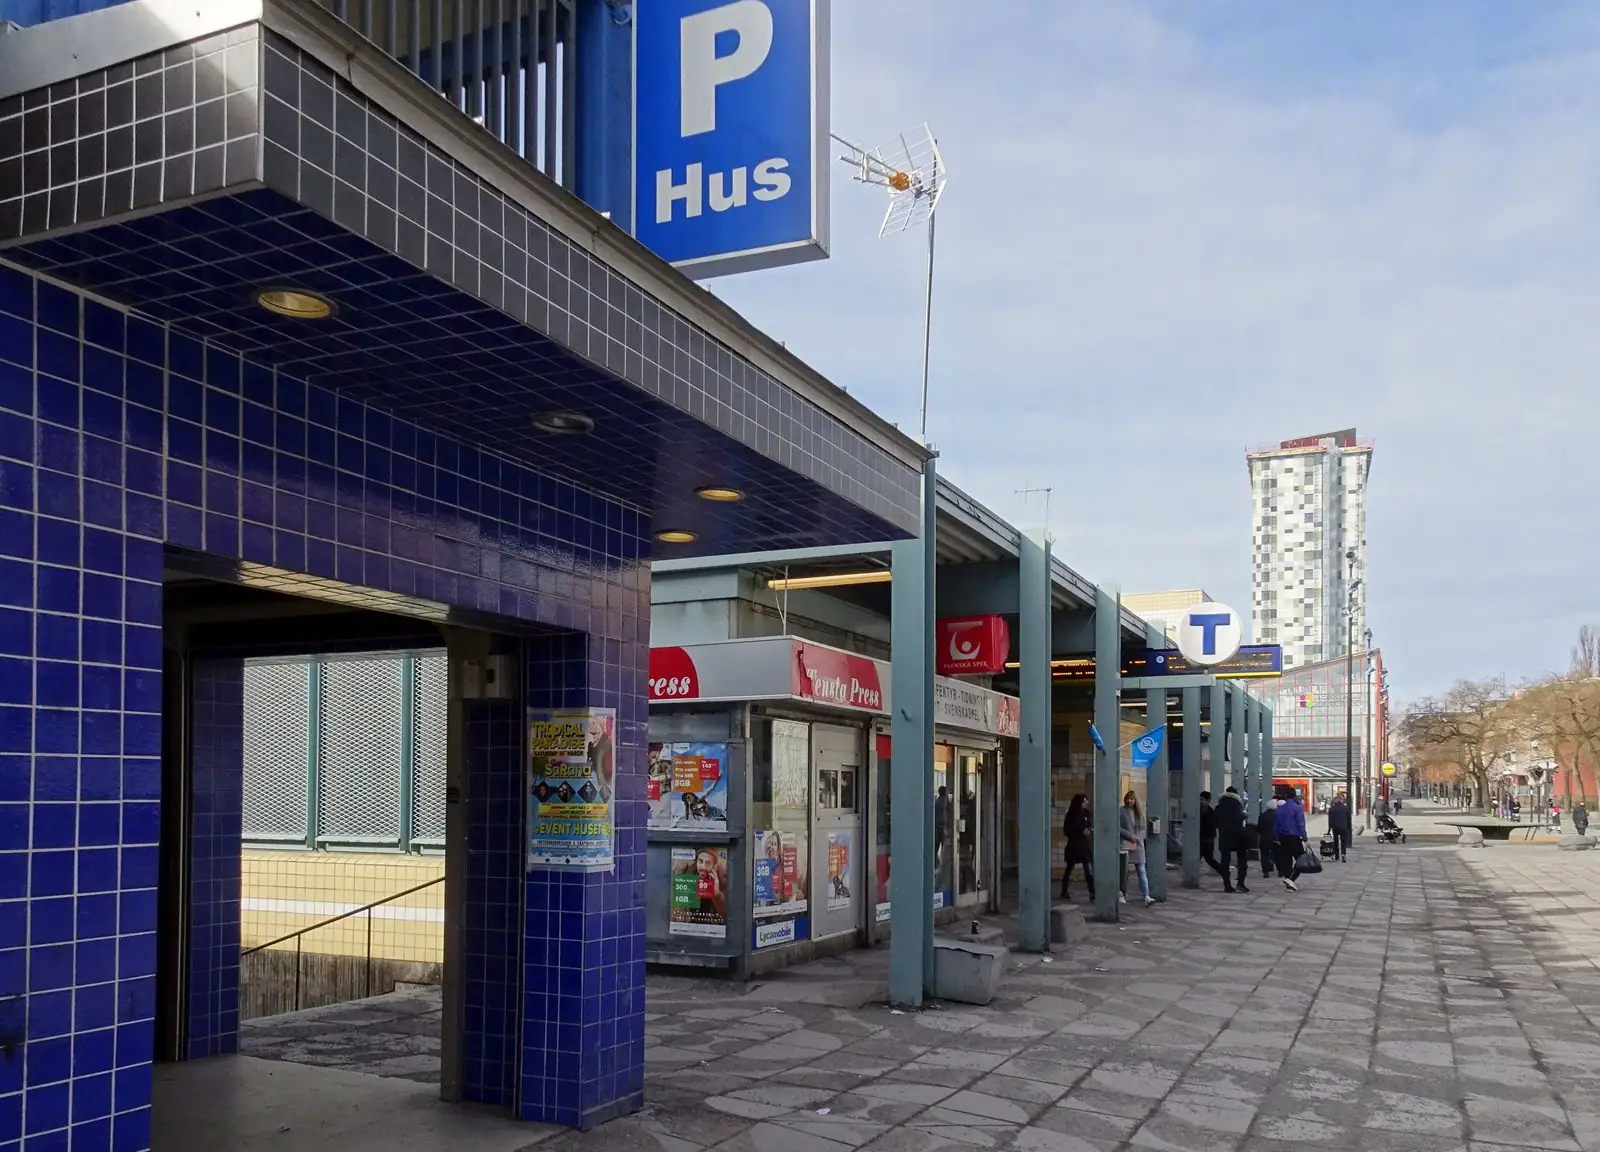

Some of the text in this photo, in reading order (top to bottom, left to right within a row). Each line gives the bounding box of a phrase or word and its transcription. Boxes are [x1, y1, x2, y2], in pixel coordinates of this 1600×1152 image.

[680, 0, 774, 138] P
[655, 157, 792, 225] Hus
[1189, 613, 1231, 656] T
[806, 668, 880, 707] Tensta Press
[532, 722, 586, 741] TROPICAL
[532, 738, 586, 750] PARADISE
[1143, 739, 1153, 748] SL
[539, 822, 603, 837] EVENT HUSET
[759, 925, 792, 943] Lycamobile
